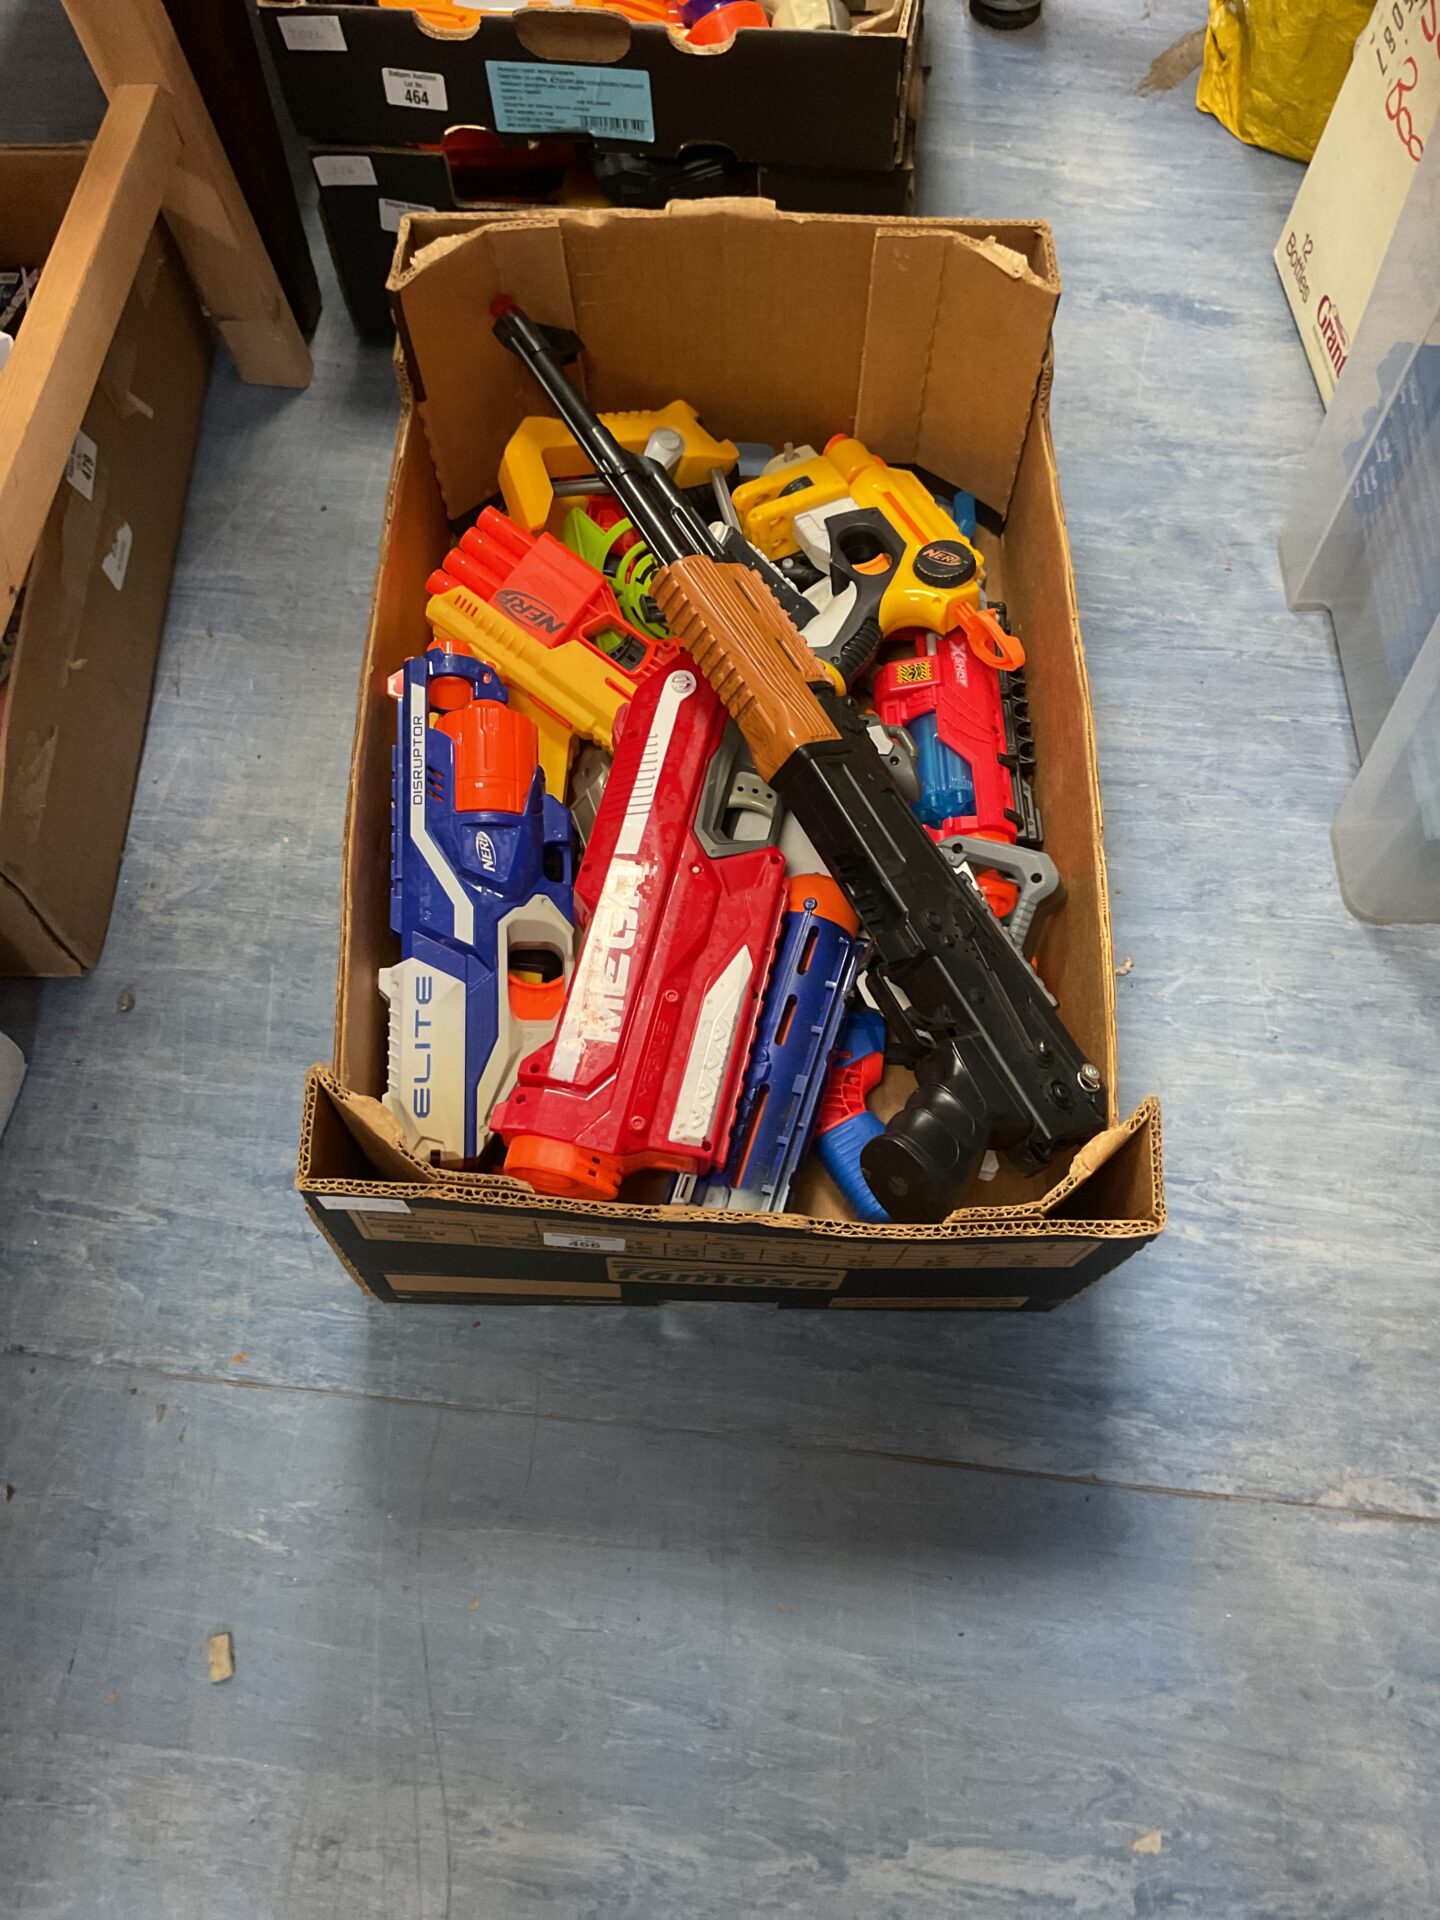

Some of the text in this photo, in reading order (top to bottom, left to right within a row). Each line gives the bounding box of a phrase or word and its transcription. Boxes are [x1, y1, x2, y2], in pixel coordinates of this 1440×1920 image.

[405, 89, 429, 106] 464
[1285, 232, 1310, 303] Bottles
[1302, 233, 1313, 262] 12
[923, 549, 961, 567] NERF
[496, 589, 566, 634] NERF
[413, 716, 423, 805] DISRUPTOR
[475, 831, 496, 872] NERF
[413, 976, 432, 1118] ELITE
